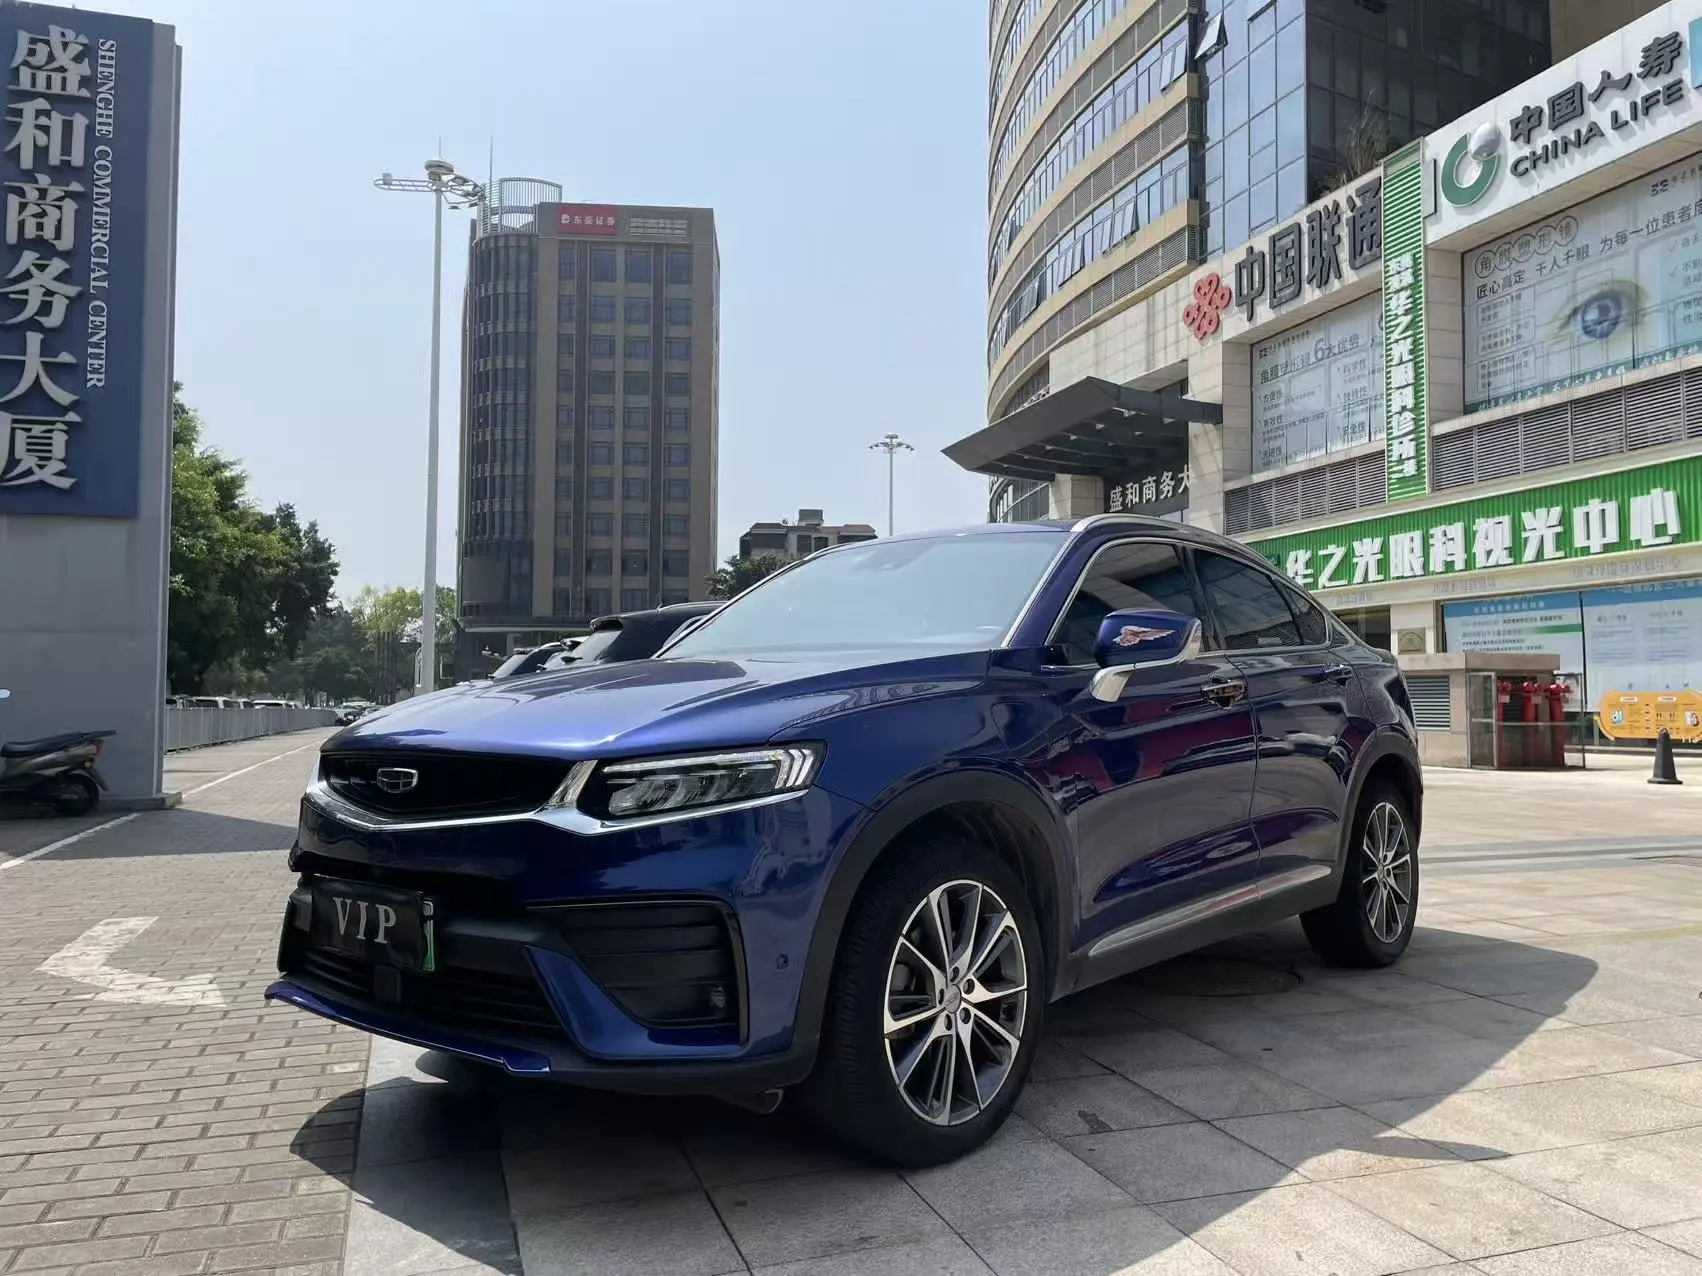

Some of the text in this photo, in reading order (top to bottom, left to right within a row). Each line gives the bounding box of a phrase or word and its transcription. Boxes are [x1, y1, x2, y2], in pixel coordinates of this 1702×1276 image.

[1510, 31, 1683, 144] 中国人寿
[1510, 78, 1684, 178] CHINA LIFE
[0, 24, 91, 489] 盛和商务大厦
[87, 38, 117, 389] SHENGHE COMMERCIAL CENTER
[1235, 176, 1382, 322] 中国联通
[1109, 464, 1191, 512] 盛和商务大
[1286, 488, 1681, 589] 华之光眼科视光中心
[333, 897, 397, 944] VIP
